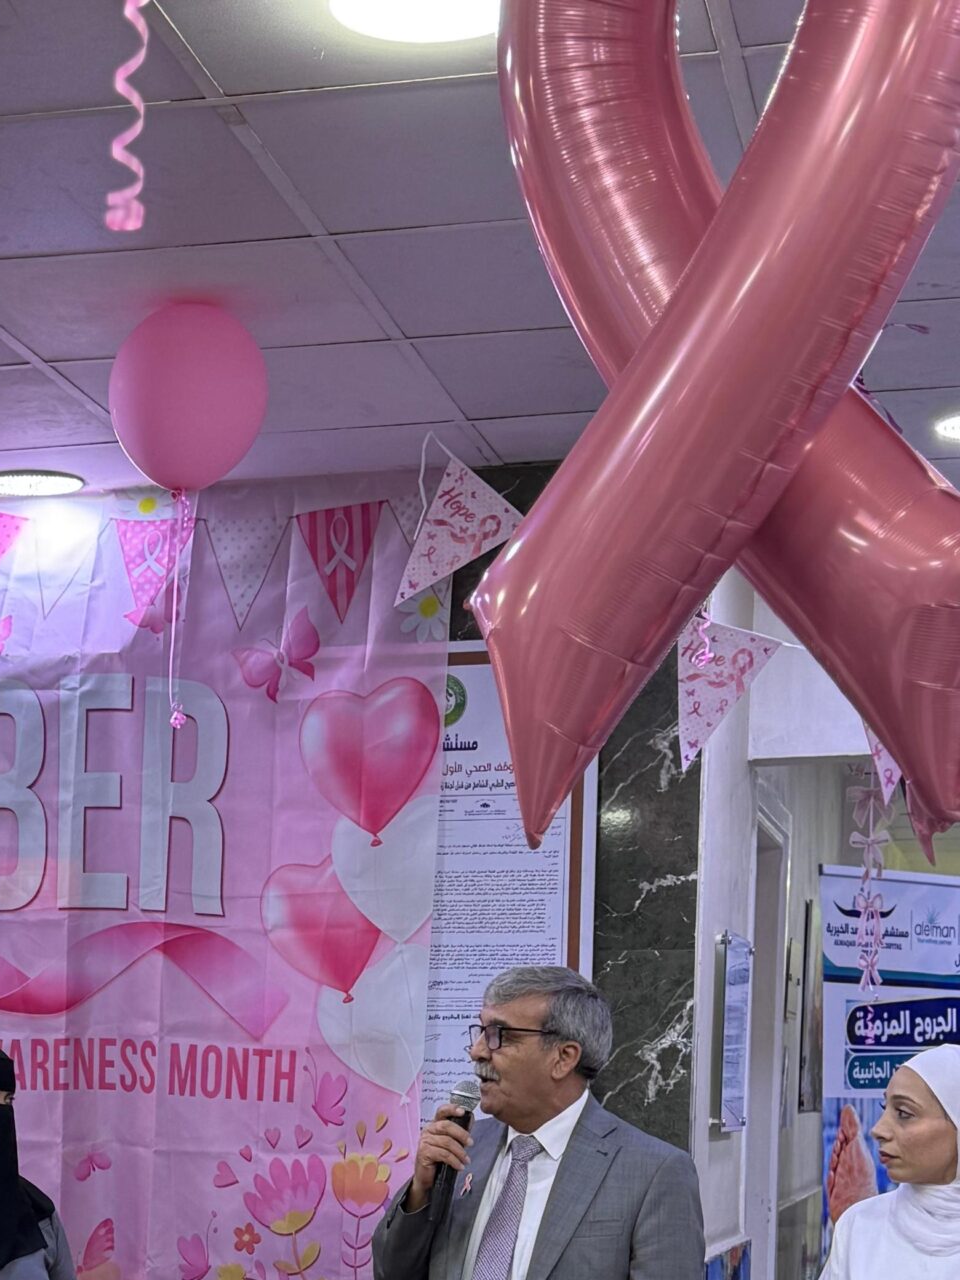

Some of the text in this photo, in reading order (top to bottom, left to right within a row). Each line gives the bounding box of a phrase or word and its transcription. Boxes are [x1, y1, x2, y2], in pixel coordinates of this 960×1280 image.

[438, 486, 477, 524] Hope
[680, 640, 727, 667] He
[854, 1007, 957, 1043] الجروح المزمة
[168, 1042, 297, 1103] MONTH
[853, 1060, 891, 1084] الجانبية
